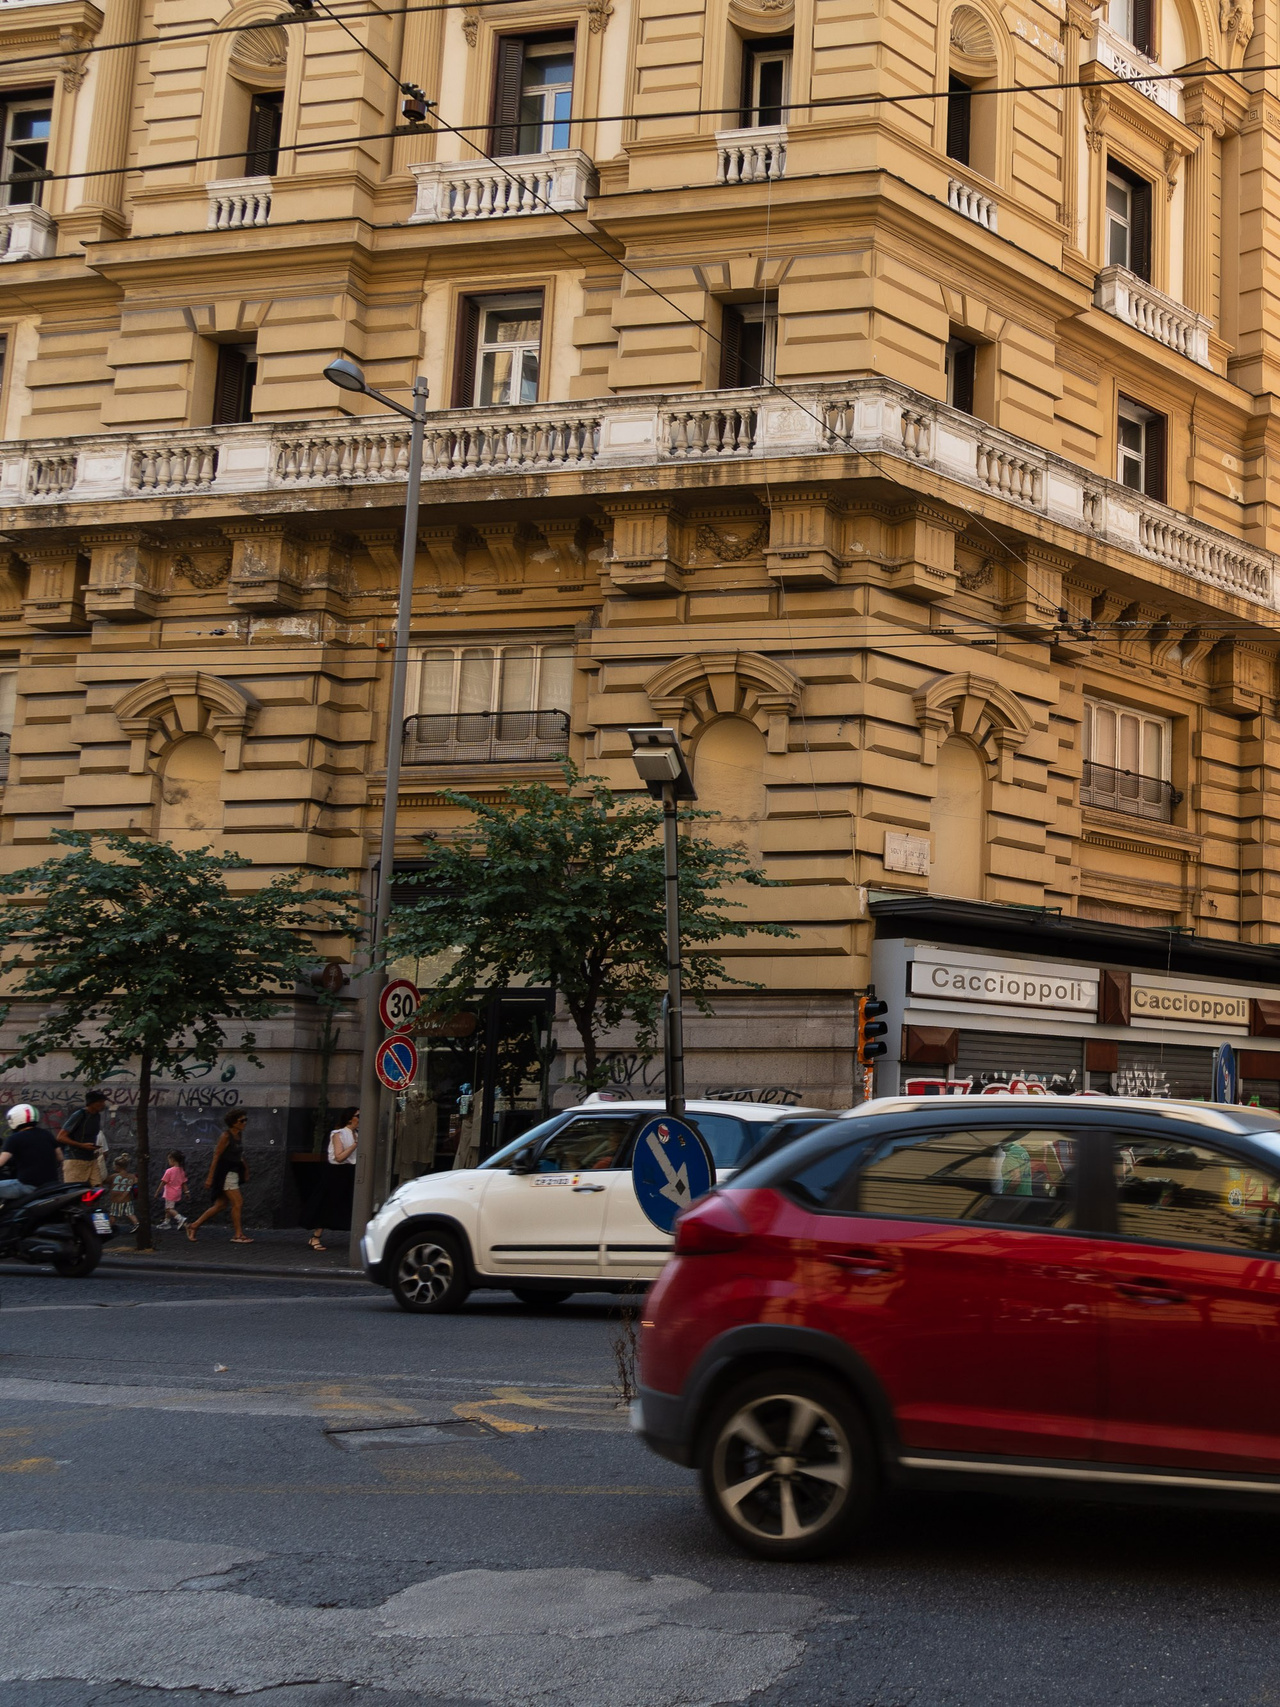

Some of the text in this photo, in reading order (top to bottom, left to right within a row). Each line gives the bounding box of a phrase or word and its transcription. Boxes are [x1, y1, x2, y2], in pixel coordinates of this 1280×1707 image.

[931, 967, 1082, 1002] Caccioppoli
[390, 993, 413, 1018] 30
[1133, 989, 1246, 1018] Caccioppoli
